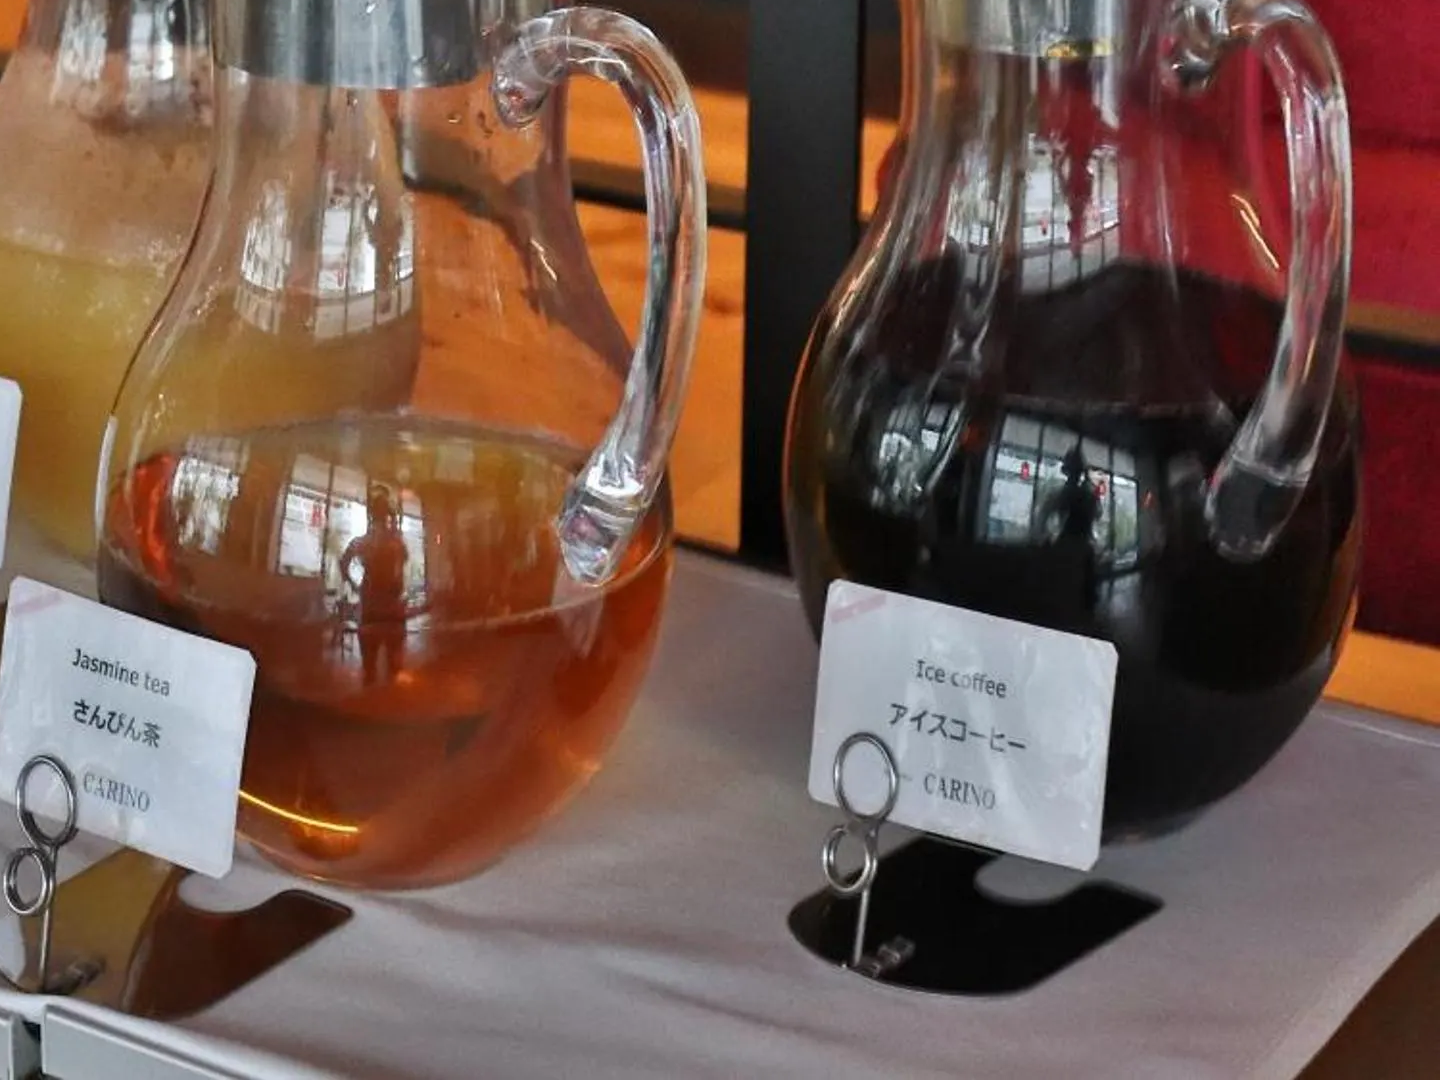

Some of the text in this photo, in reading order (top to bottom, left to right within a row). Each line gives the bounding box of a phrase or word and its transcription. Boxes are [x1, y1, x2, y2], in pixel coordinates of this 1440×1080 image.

[72, 648, 171, 697] Jasmine tea
[916, 659, 1007, 699] Ice coffee
[888, 702, 1027, 753] アイスコーヒー
[83, 771, 151, 813] CARINO
[923, 773, 997, 810] CARINO
